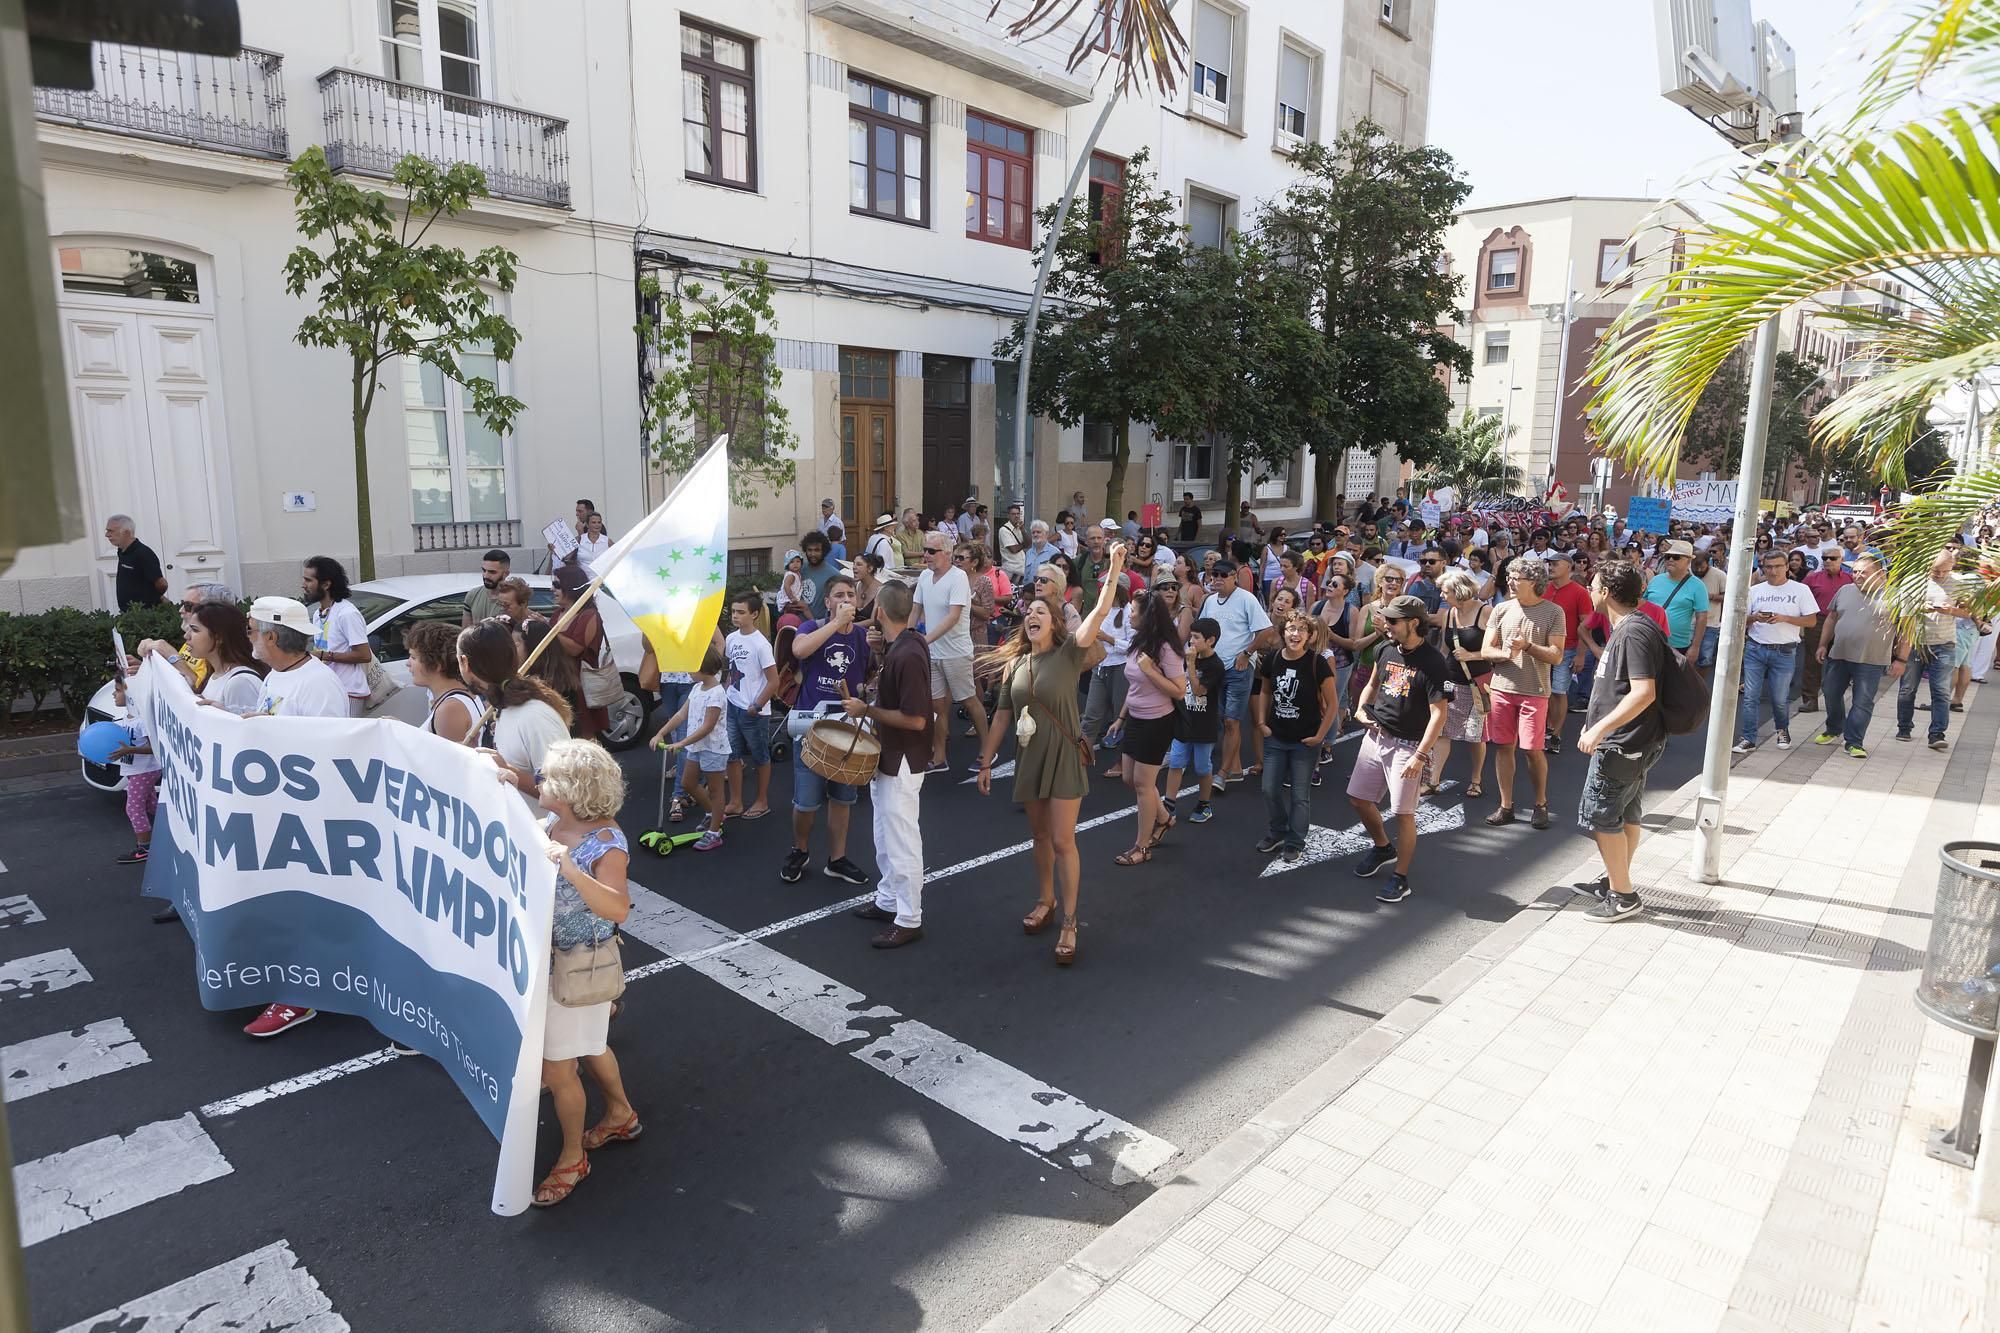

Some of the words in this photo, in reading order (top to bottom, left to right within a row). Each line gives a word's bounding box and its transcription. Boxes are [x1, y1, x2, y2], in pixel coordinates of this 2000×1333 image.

[1704, 482, 1739, 504] MA
[1757, 595, 1786, 603] Hurley
[212, 742, 321, 802] LOS
[332, 758, 528, 912] VERTIDOS!
[205, 804, 384, 882] MAR
[393, 830, 530, 997] LIMPIO
[332, 966, 369, 995] de
[373, 977, 449, 1049] Nuestra
[451, 1031, 499, 1103] Tierra
